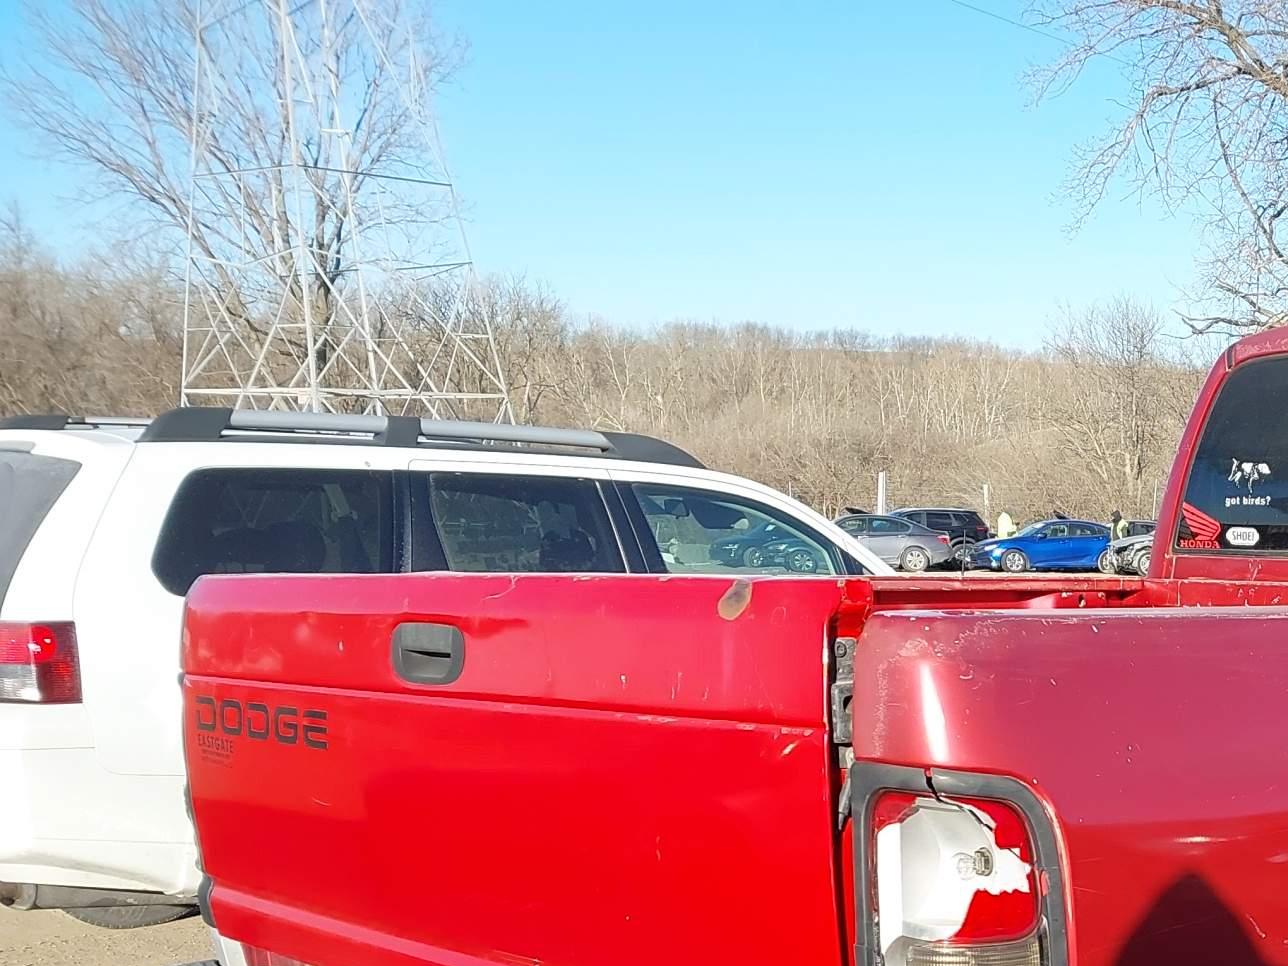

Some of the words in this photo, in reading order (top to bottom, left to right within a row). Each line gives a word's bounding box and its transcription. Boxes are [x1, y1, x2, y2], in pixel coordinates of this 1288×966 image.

[1225, 495, 1241, 508] got
[1243, 495, 1271, 506] birds?
[1180, 540, 1220, 549] HONDA
[196, 695, 328, 750] DODGE
[197, 734, 234, 754] EASTGATE
